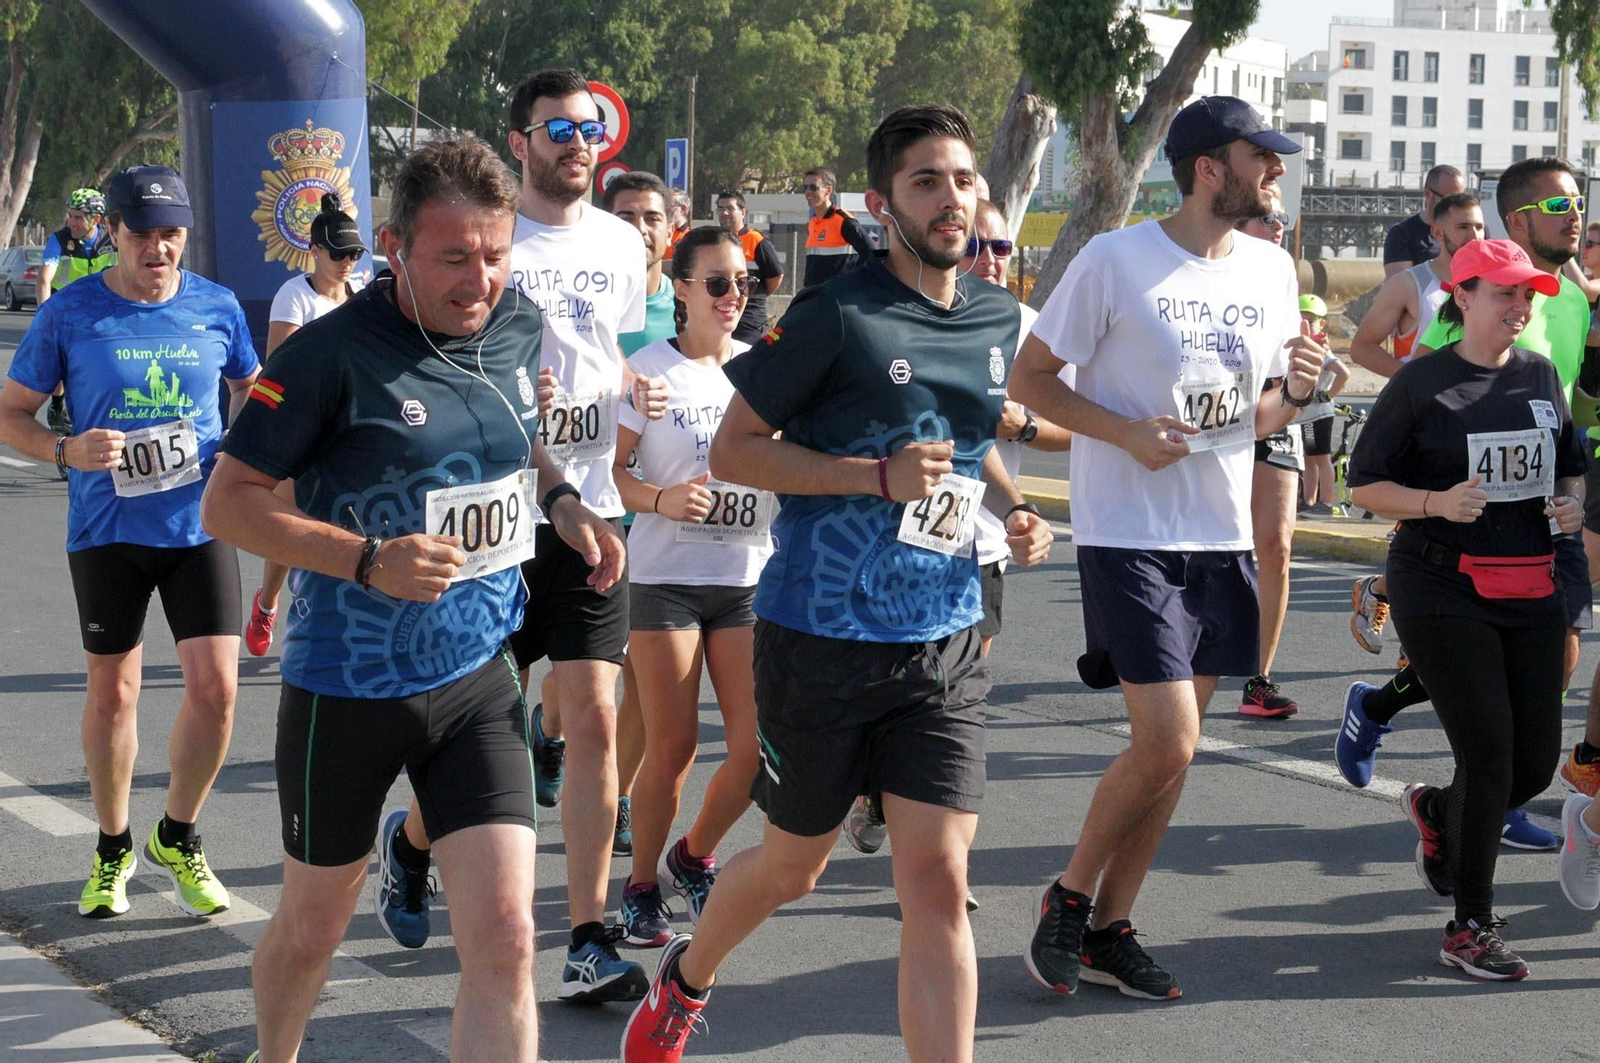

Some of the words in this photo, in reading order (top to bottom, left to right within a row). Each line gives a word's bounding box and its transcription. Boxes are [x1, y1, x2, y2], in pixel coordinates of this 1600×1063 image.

[669, 147, 681, 189] P
[511, 269, 564, 294] RUTA
[574, 271, 614, 294] 091
[536, 299, 595, 319] HUELVA
[1157, 297, 1212, 323] RUTA
[1223, 304, 1264, 329] 091
[116, 349, 131, 360] 10
[133, 349, 152, 359] km
[155, 343, 199, 359] Huelva
[1181, 331, 1244, 354] HUELVA
[537, 403, 599, 446] 4280
[672, 406, 723, 429] RUTA
[1183, 386, 1240, 431] 4262
[118, 434, 186, 479] 4015
[1477, 443, 1543, 483] 4134
[438, 492, 519, 553] 4009
[703, 490, 758, 528] 288
[912, 490, 971, 543] 4258
